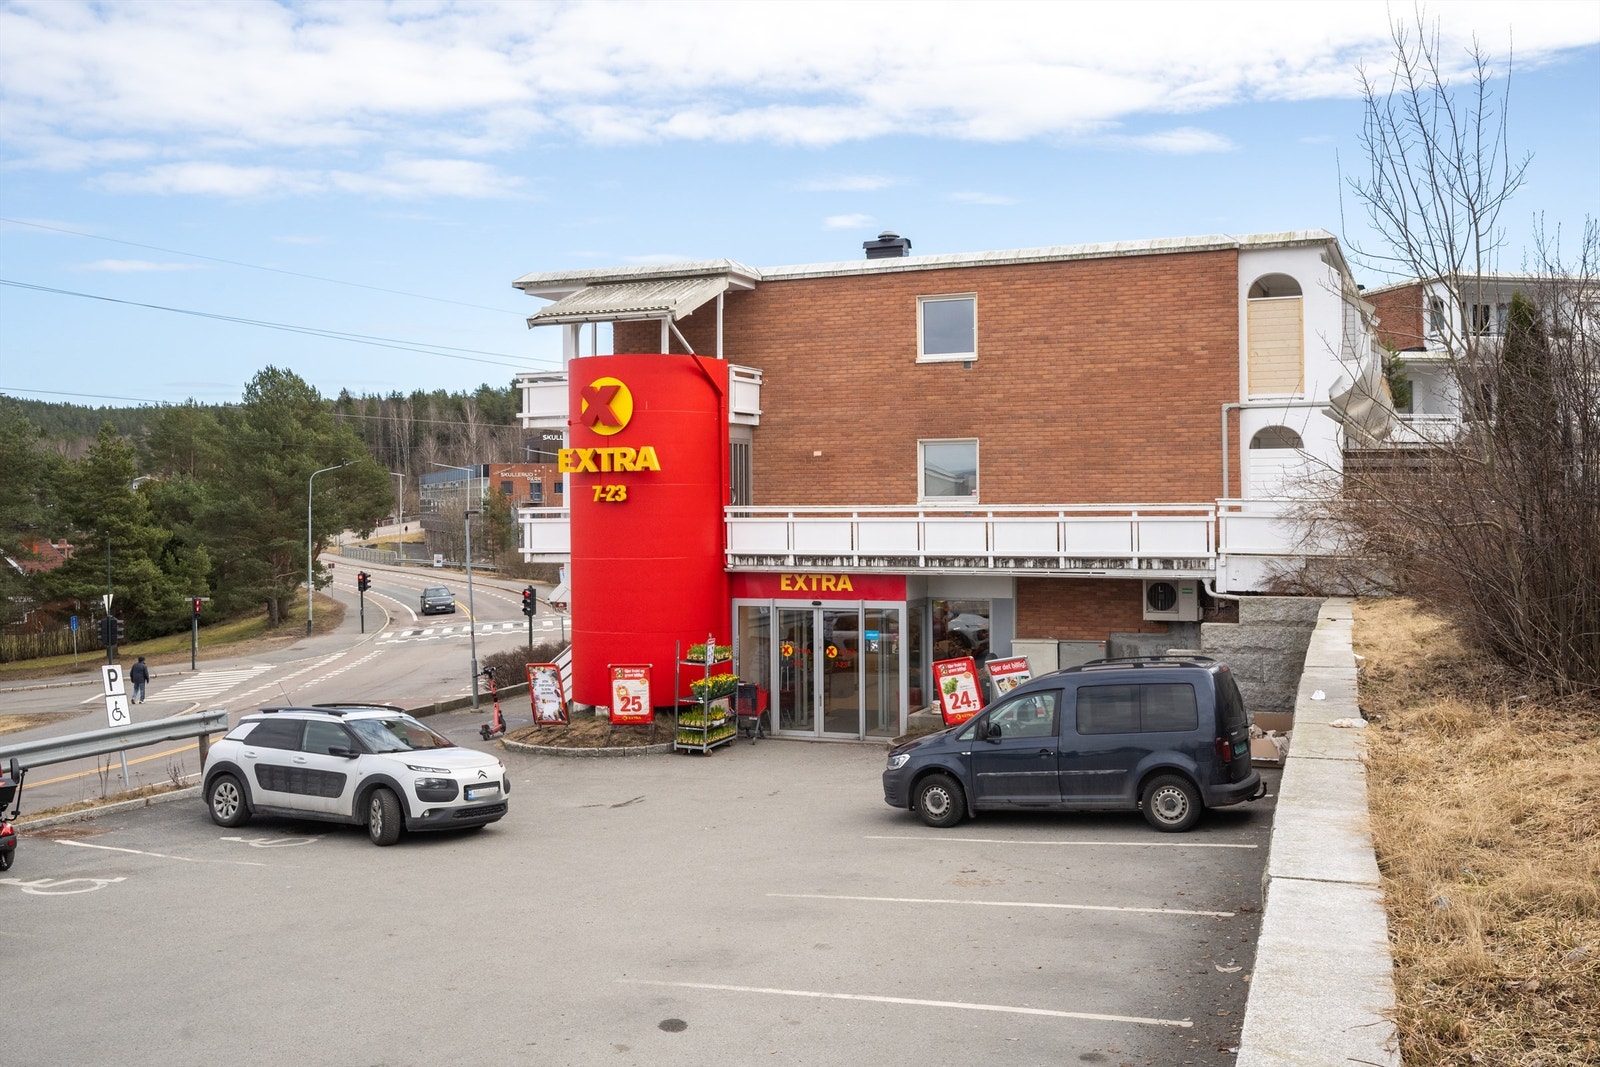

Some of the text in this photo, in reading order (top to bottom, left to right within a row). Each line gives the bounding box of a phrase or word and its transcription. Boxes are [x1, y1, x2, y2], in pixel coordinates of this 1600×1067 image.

[558, 446, 661, 473] EXTRA
[592, 485, 627, 502] 7-23
[781, 573, 854, 592] EXTRA
[1002, 663, 1012, 671] det
[107, 668, 118, 692] P
[620, 695, 643, 712] 25
